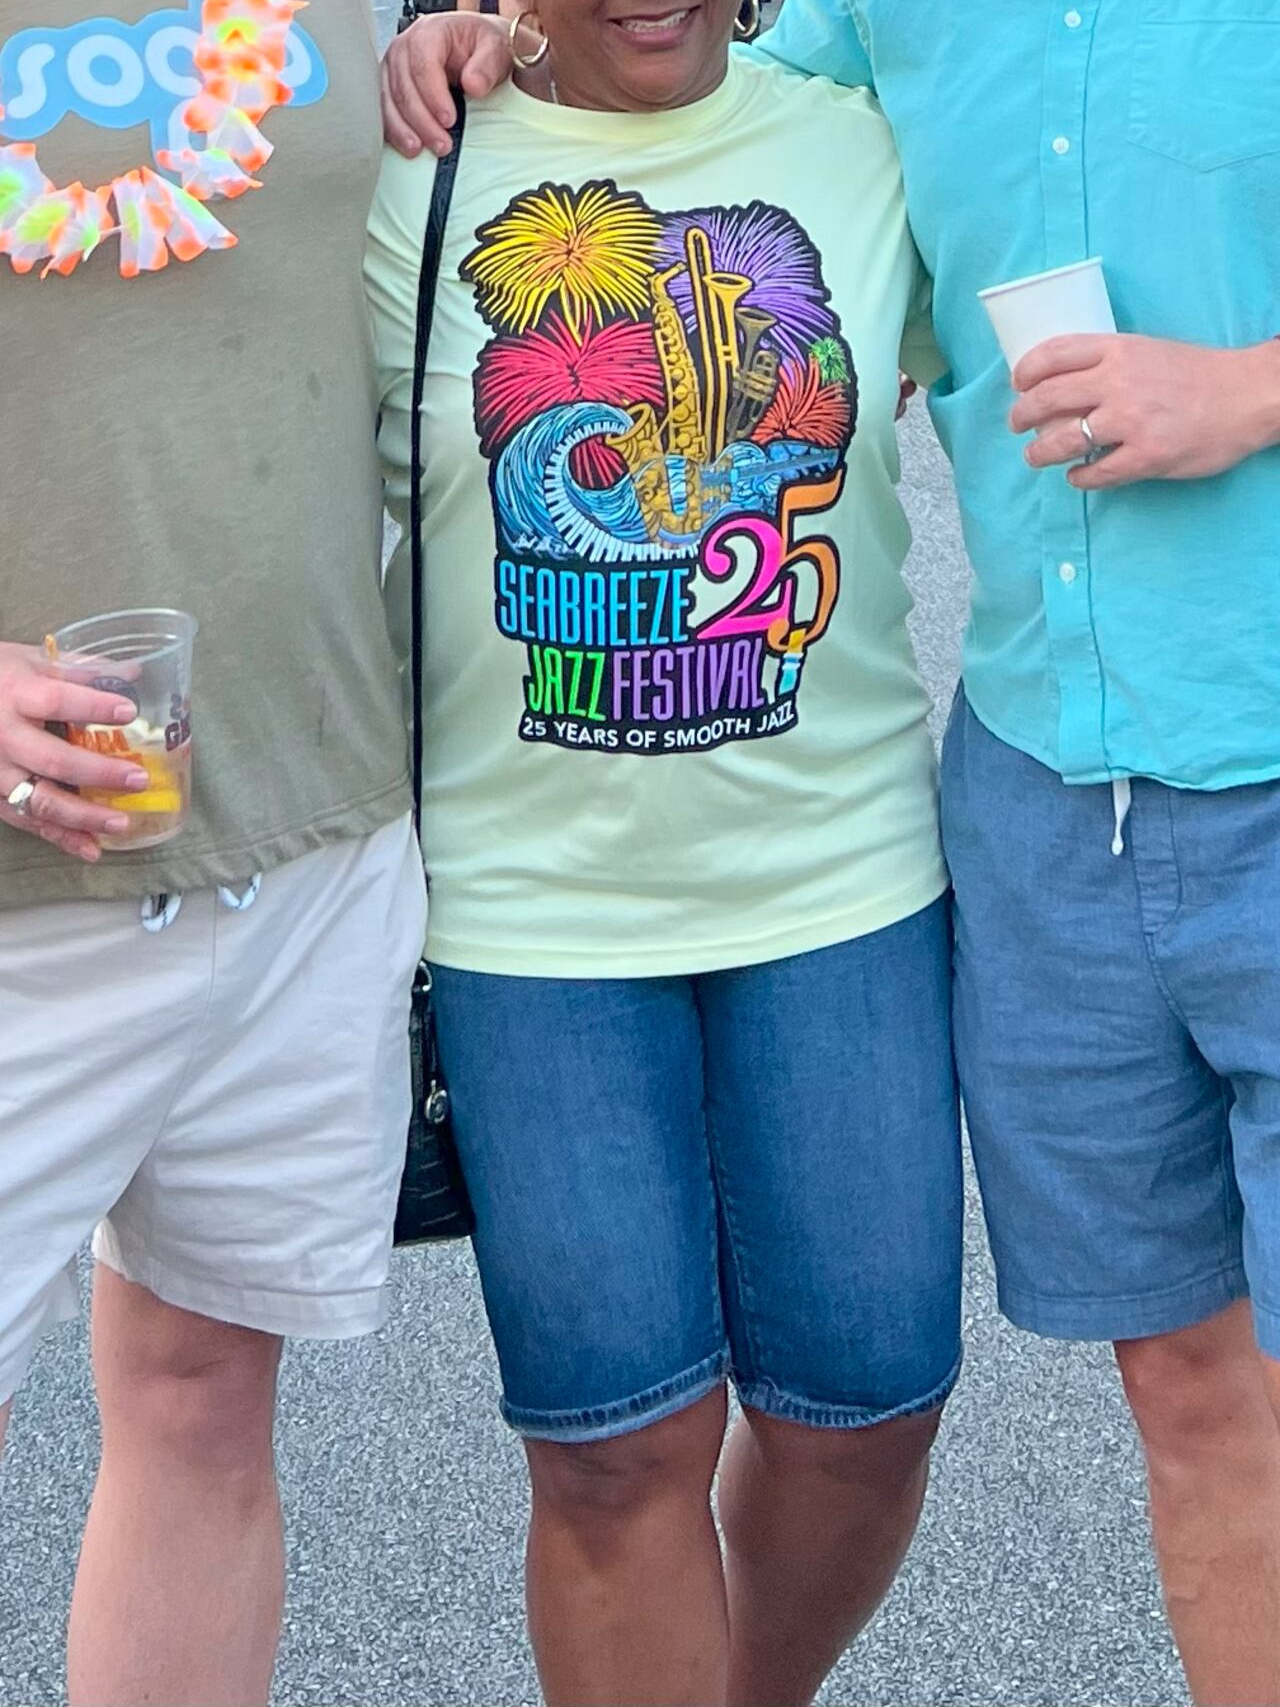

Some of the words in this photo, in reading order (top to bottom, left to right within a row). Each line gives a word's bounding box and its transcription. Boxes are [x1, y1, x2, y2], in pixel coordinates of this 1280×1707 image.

[499, 559, 690, 646] SEABREEZE
[696, 468, 840, 652] 25
[528, 643, 607, 722] JAZZ
[612, 637, 766, 722] FESTIVAL
[522, 716, 547, 737] 25
[552, 720, 619, 748] YEARS
[625, 729, 656, 748] OF
[663, 717, 751, 748] SMOOTH
[756, 699, 795, 733] JAZZ
